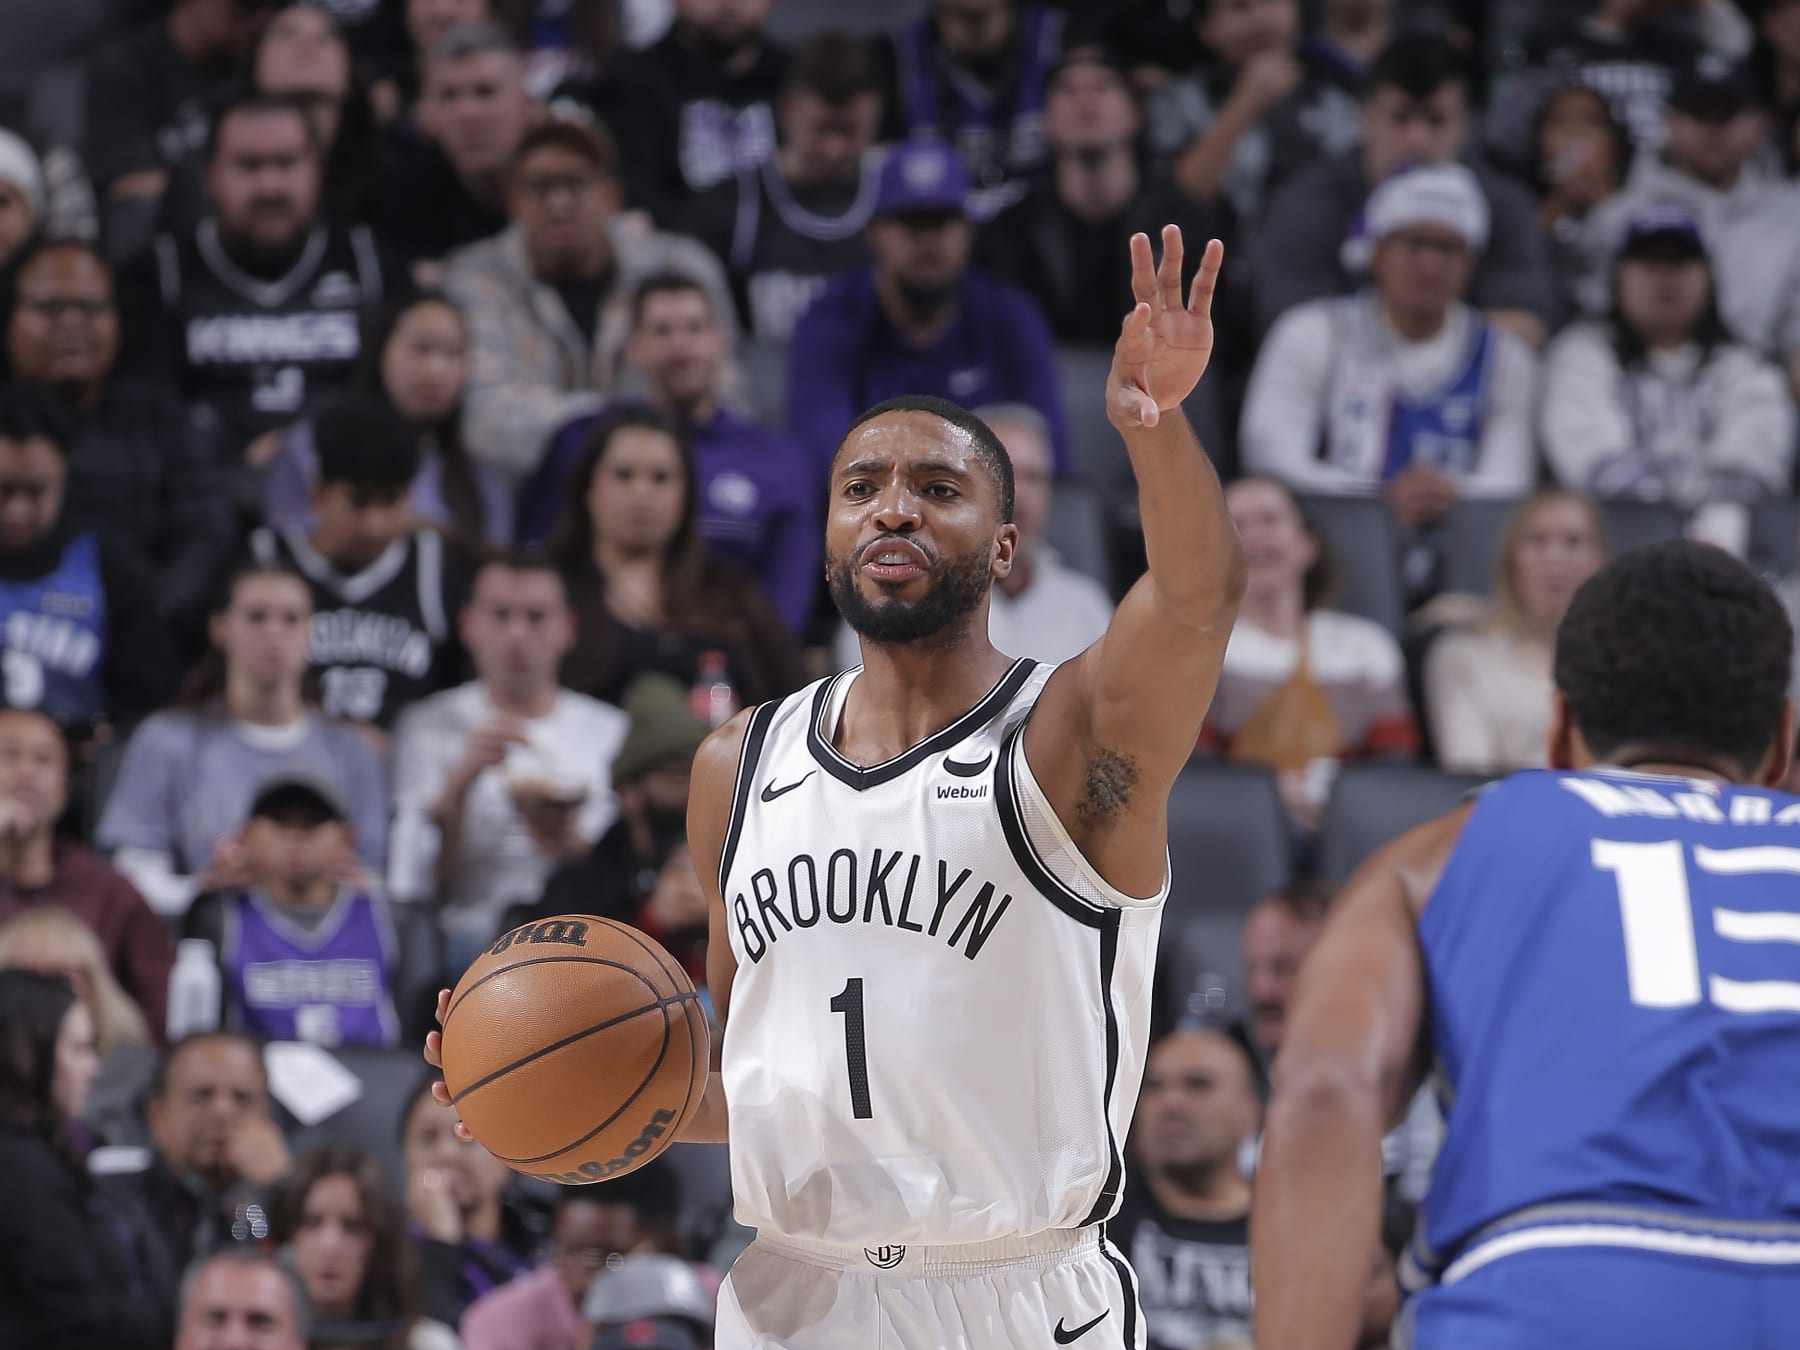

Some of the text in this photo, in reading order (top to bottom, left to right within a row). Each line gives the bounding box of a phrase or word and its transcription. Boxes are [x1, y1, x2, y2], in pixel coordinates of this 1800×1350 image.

[937, 784, 987, 799] Webull
[734, 848, 1013, 964] BROOKLYN
[1590, 838, 1800, 1014] 13
[830, 977, 873, 1120] 1
